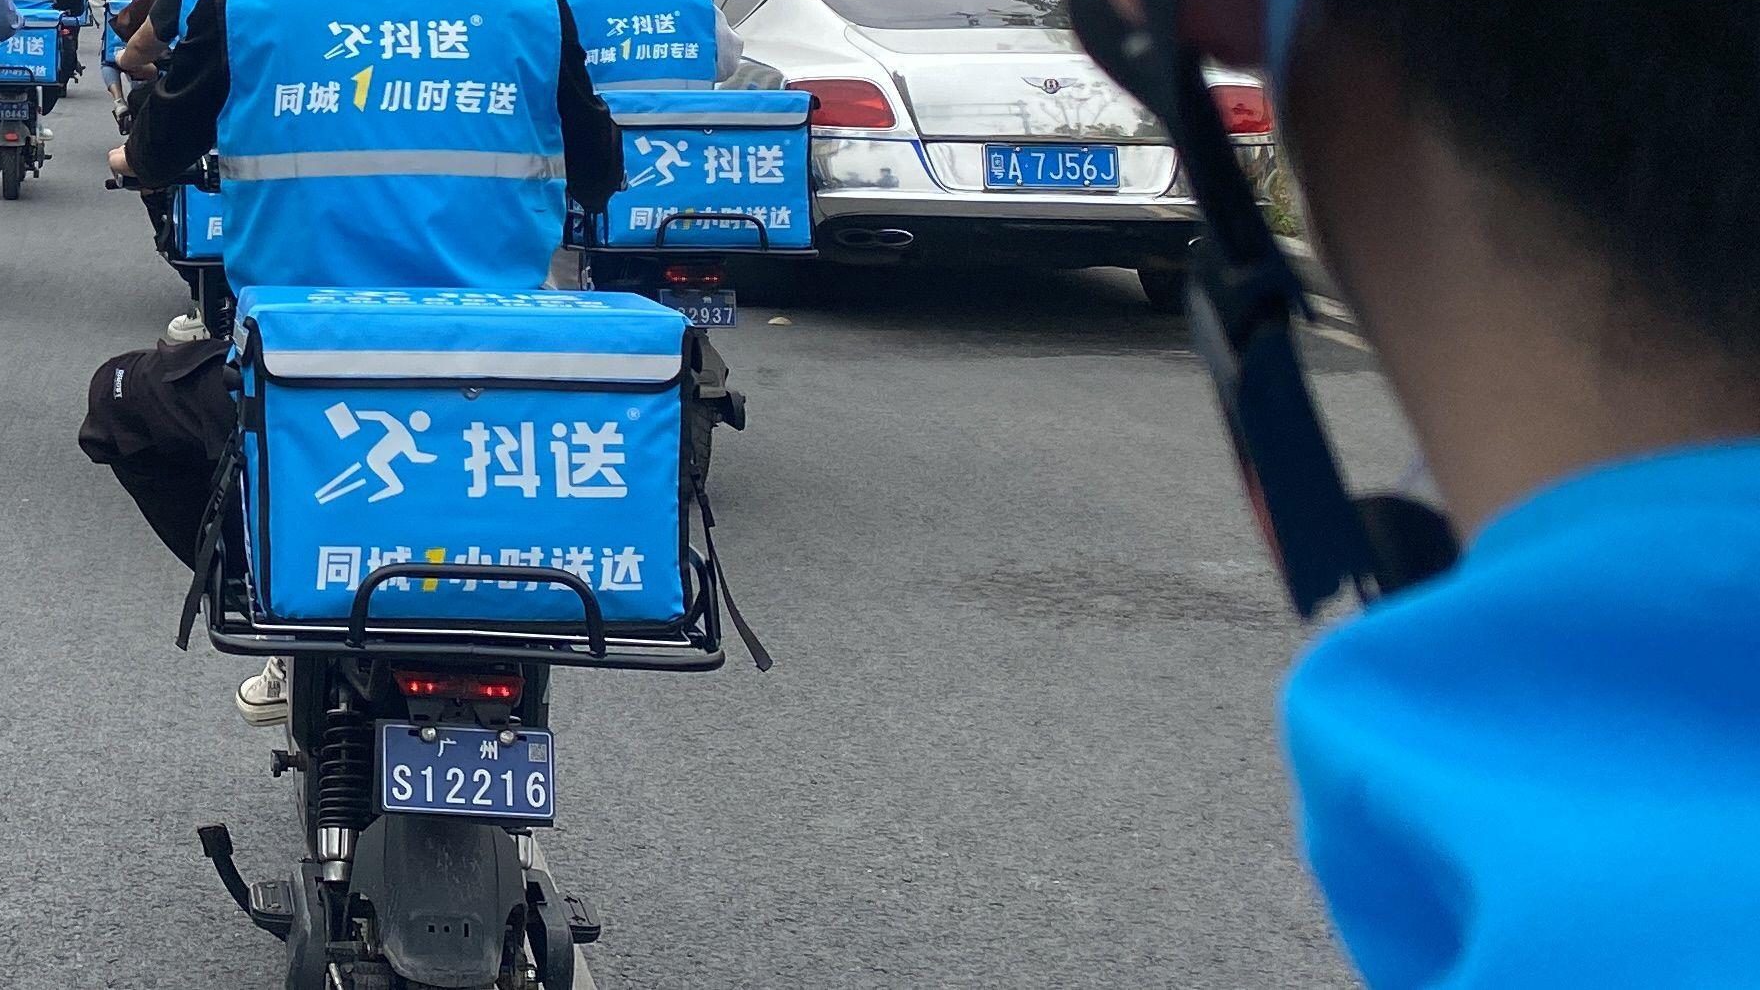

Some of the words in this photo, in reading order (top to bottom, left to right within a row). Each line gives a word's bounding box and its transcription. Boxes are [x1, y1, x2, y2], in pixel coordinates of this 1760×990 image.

[584, 37, 700, 67] 同城1小时专送
[274, 65, 518, 117] 同城1小时专送
[437, 737, 499, 761] 广州
[391, 763, 547, 809] S12216
